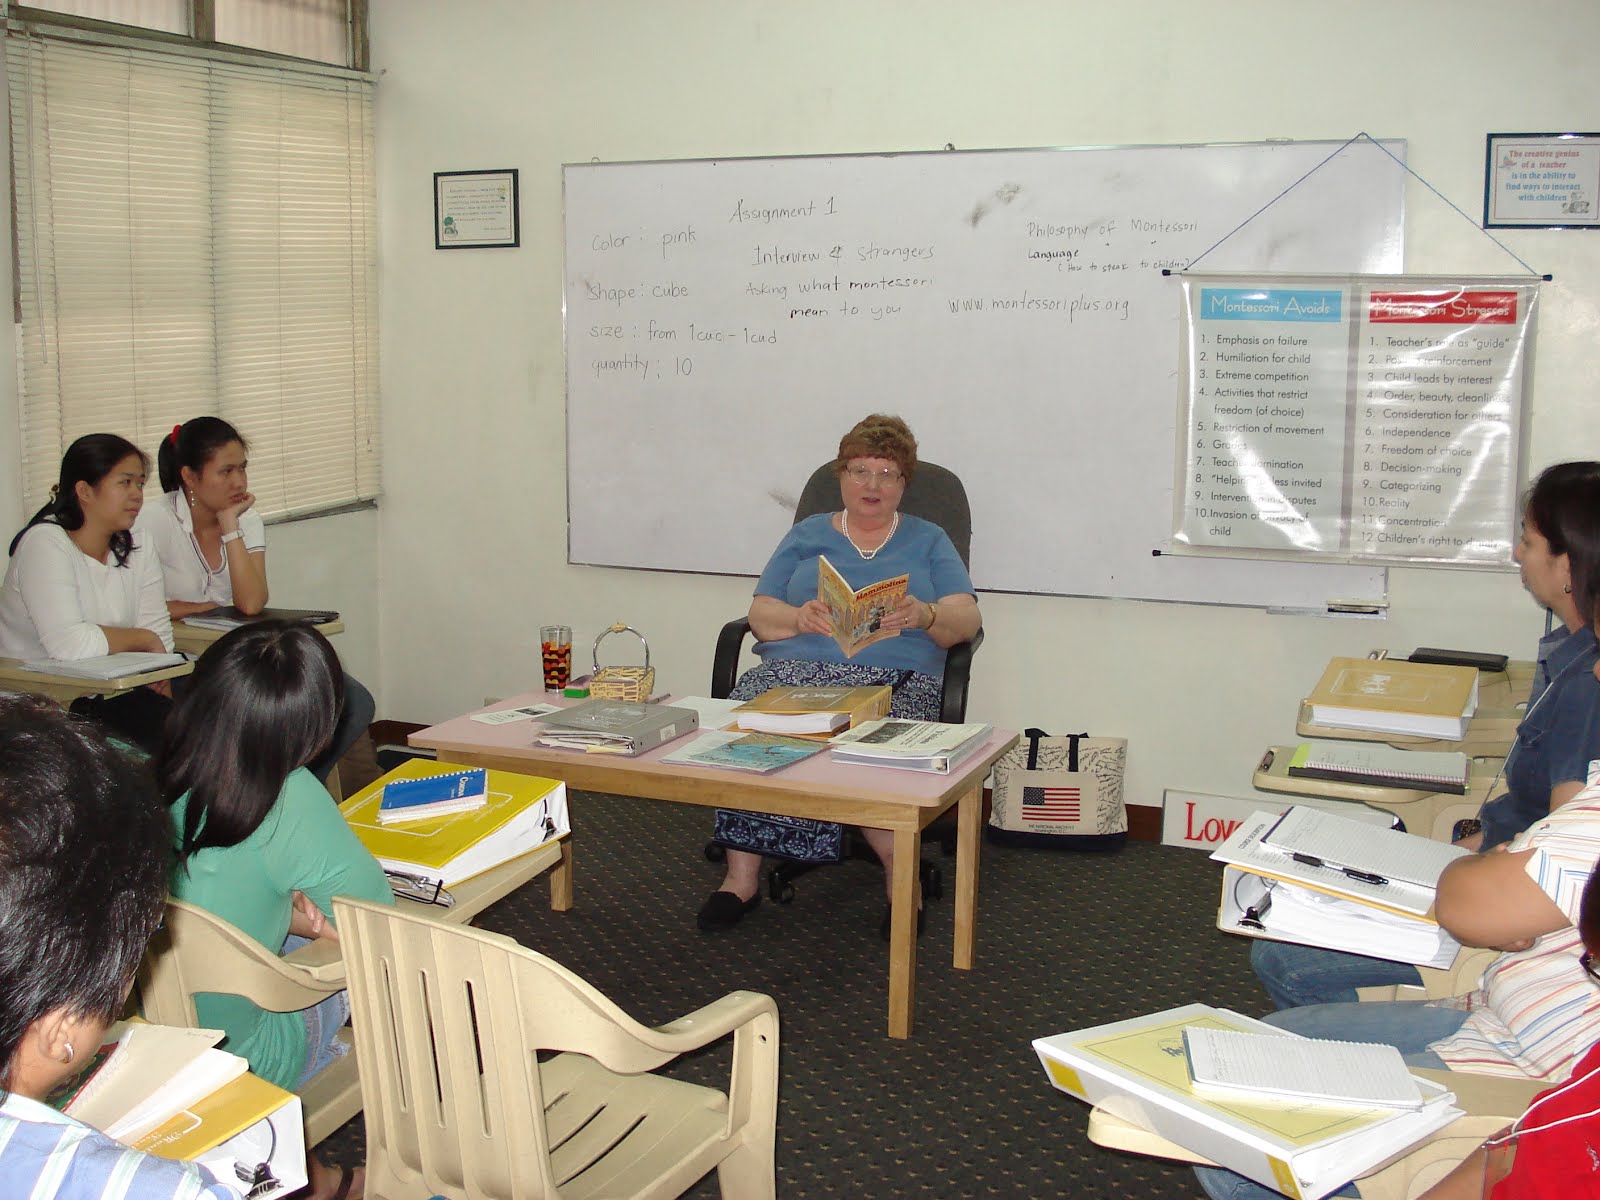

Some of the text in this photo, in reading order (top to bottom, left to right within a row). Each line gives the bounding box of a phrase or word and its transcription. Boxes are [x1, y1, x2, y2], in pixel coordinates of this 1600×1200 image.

[729, 196, 838, 223] Assignment 1
[1027, 219, 1197, 239] Philosophy of Montessori
[662, 225, 696, 259] pink
[752, 246, 820, 266] Interview
[1028, 249, 1079, 262] Language
[1102, 264, 1129, 272] speak
[1140, 260, 1149, 268] to
[745, 275, 934, 299] Asking what montessori
[790, 301, 901, 320] mean to you
[1211, 295, 1330, 315] Montessori Avoids
[648, 320, 676, 341] from
[1202, 334, 1209, 343] 1.
[1217, 335, 1259, 346] Emphasis
[1278, 336, 1307, 345] failure
[1370, 337, 1378, 346] 1.
[1387, 337, 1432, 347] Teacher's
[1458, 339, 1468, 348] as
[1200, 352, 1311, 363] 2. Humiliation for child
[1368, 355, 1377, 364] 2.
[675, 357, 692, 376] 10
[1200, 370, 1309, 382] 3. Extreme competition
[1385, 373, 1411, 382] Child
[1414, 373, 1440, 383] leads
[1443, 375, 1455, 385] by
[1458, 375, 1492, 384] interest
[1198, 387, 1308, 399] 4. Activities that restrict
[1214, 405, 1304, 418] freedom (of choice)
[1366, 409, 1375, 418] 5.
[1383, 409, 1451, 420] Consideration
[1454, 410, 1468, 419] for
[1198, 422, 1324, 435] 5. Restriction of movement
[1365, 427, 1451, 439] 6. Independence
[1197, 440, 1205, 448] 6.
[1365, 444, 1373, 453] 7.
[1382, 445, 1423, 455] Freedom
[1427, 446, 1437, 455] of
[1196, 457, 1205, 466] 7.
[1364, 462, 1372, 471] 8.
[1195, 474, 1204, 482] 8.
[1292, 478, 1322, 488] invited
[1363, 480, 1441, 493] 9. Categorizing
[1195, 491, 1203, 500] 9.
[1380, 498, 1410, 509] Reality
[1195, 508, 1209, 517] 10.
[1210, 509, 1247, 519] Invasion
[1210, 526, 1231, 536] child
[1378, 532, 1425, 544] Children's
[1428, 535, 1450, 547] right
[1453, 538, 1462, 546] to
